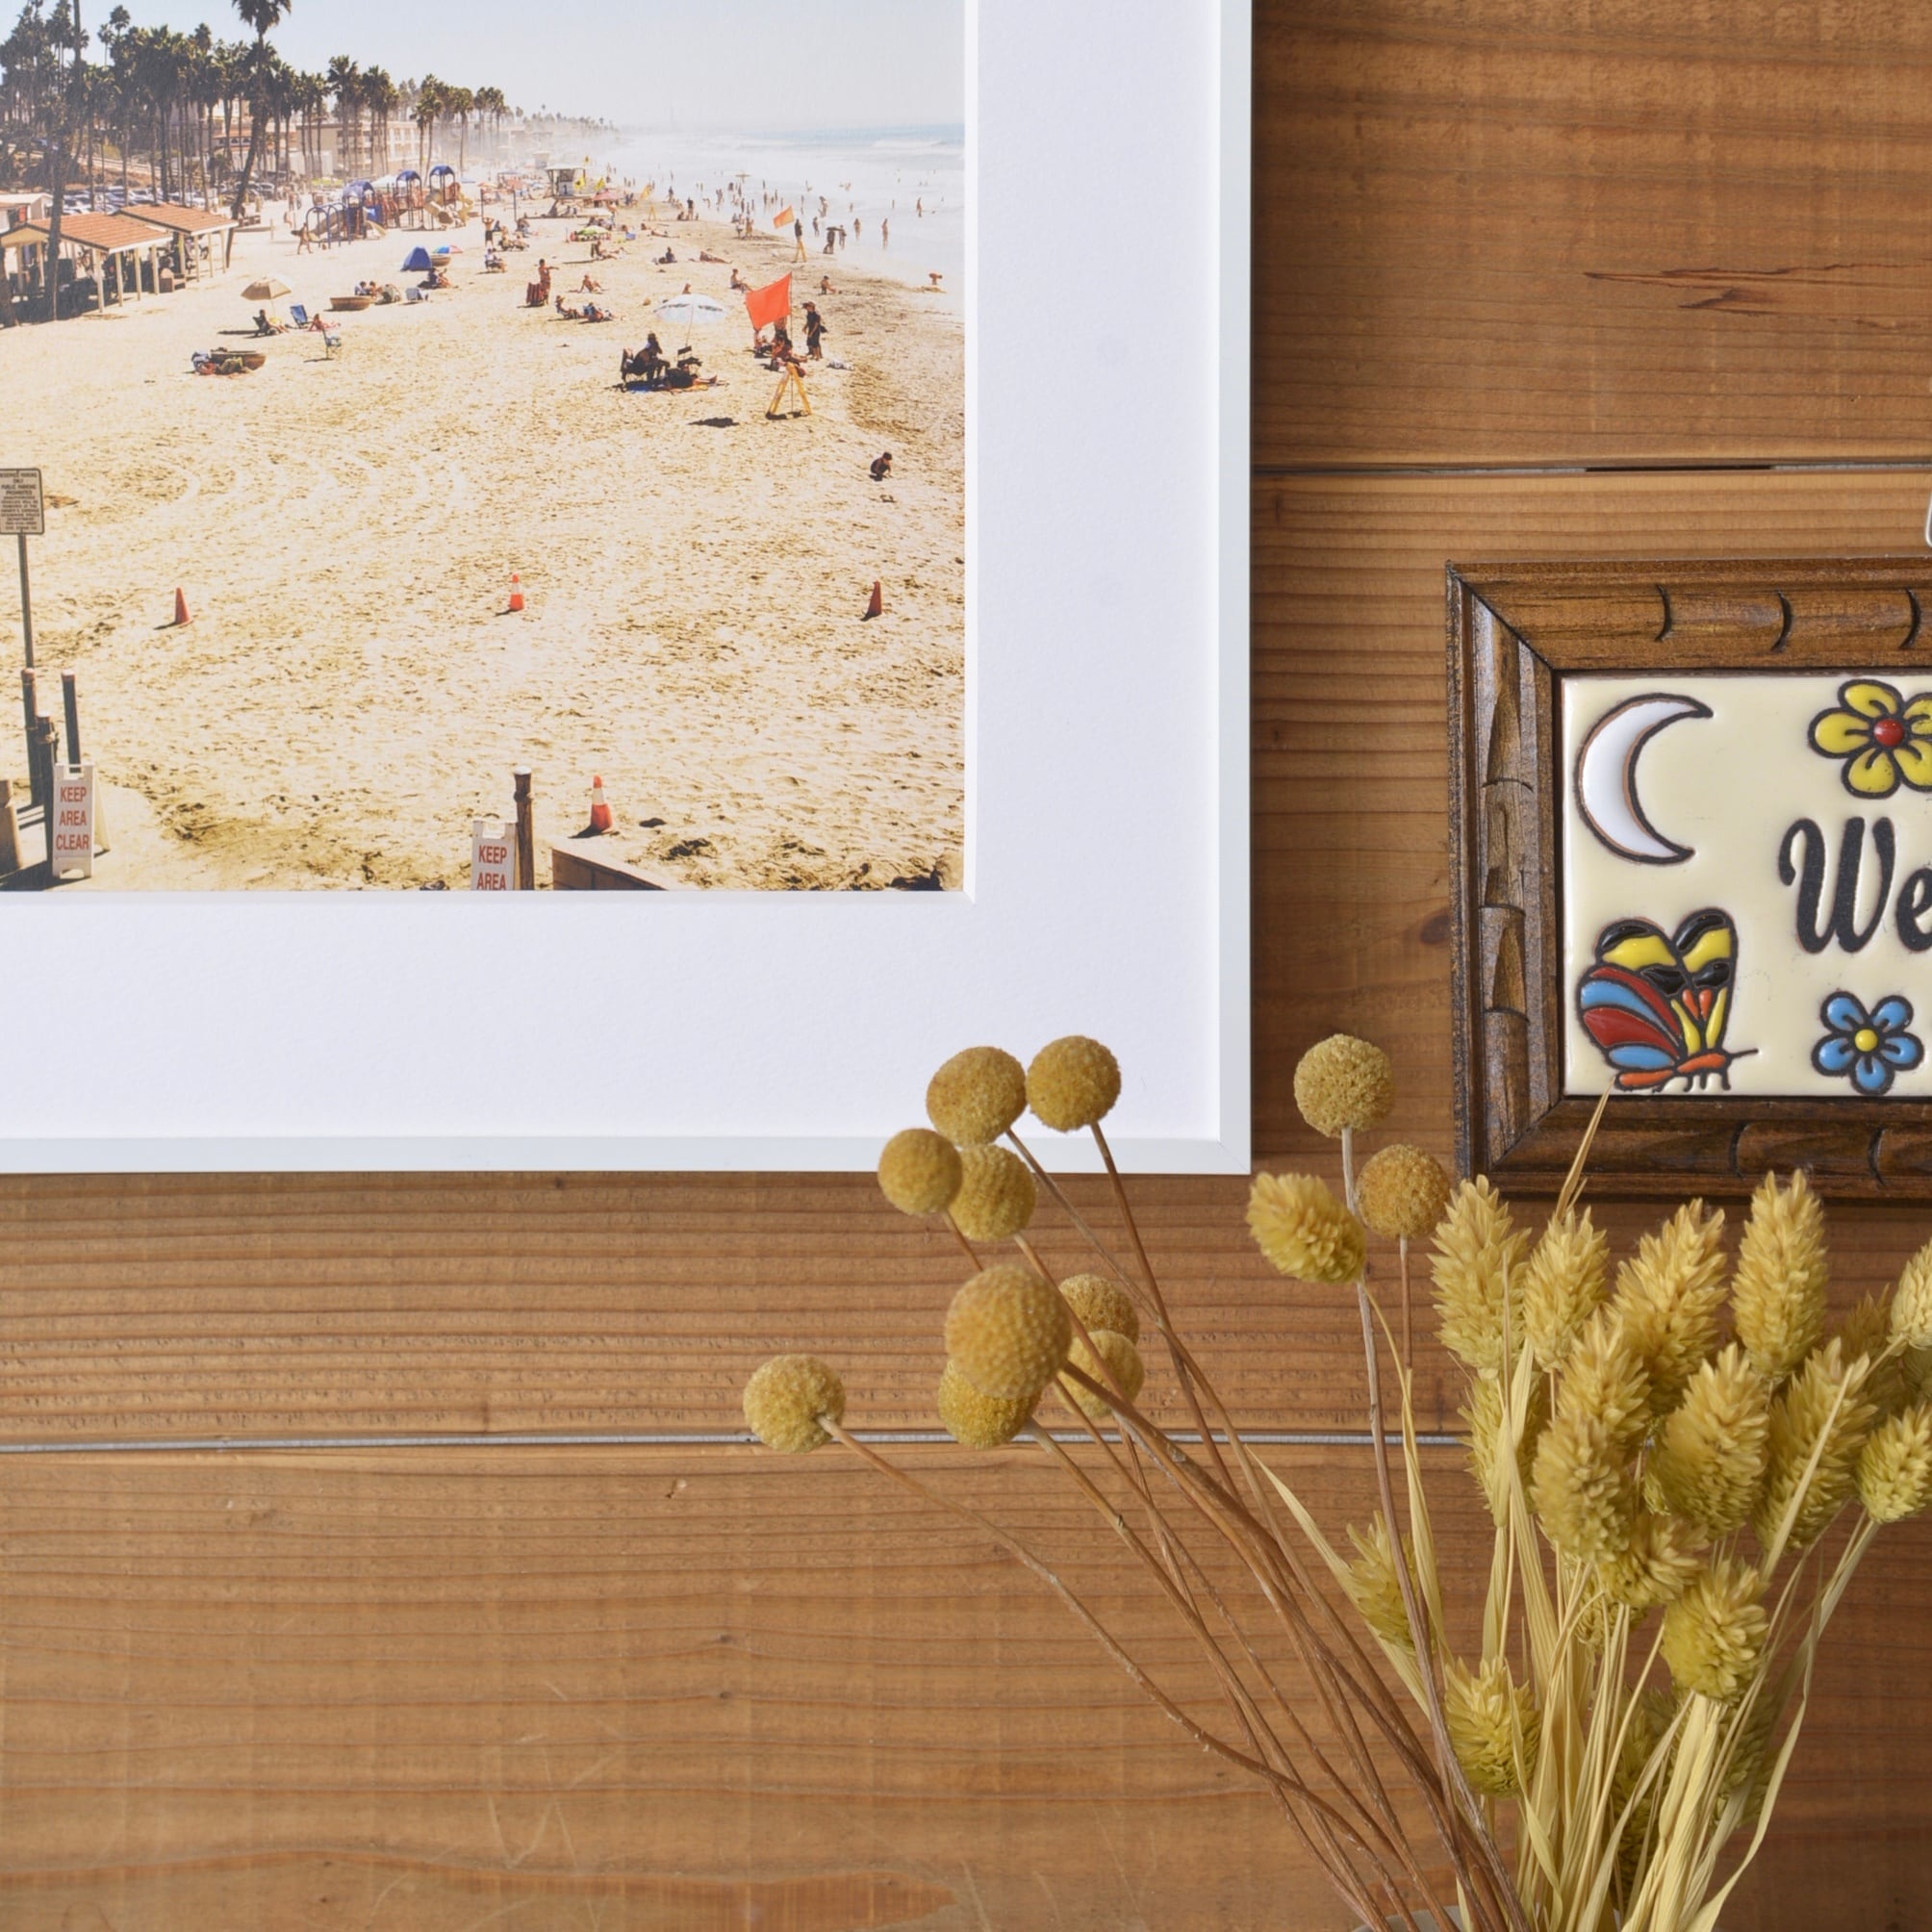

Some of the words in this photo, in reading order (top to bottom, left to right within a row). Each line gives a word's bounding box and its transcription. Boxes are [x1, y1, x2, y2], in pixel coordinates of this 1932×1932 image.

[60, 786, 88, 802] KEEP
[59, 810, 88, 826] AREA
[56, 833, 90, 851] CLEAR
[478, 845, 508, 865] KEEP
[476, 872, 507, 891] AREA
[1778, 816, 1932, 954] We
